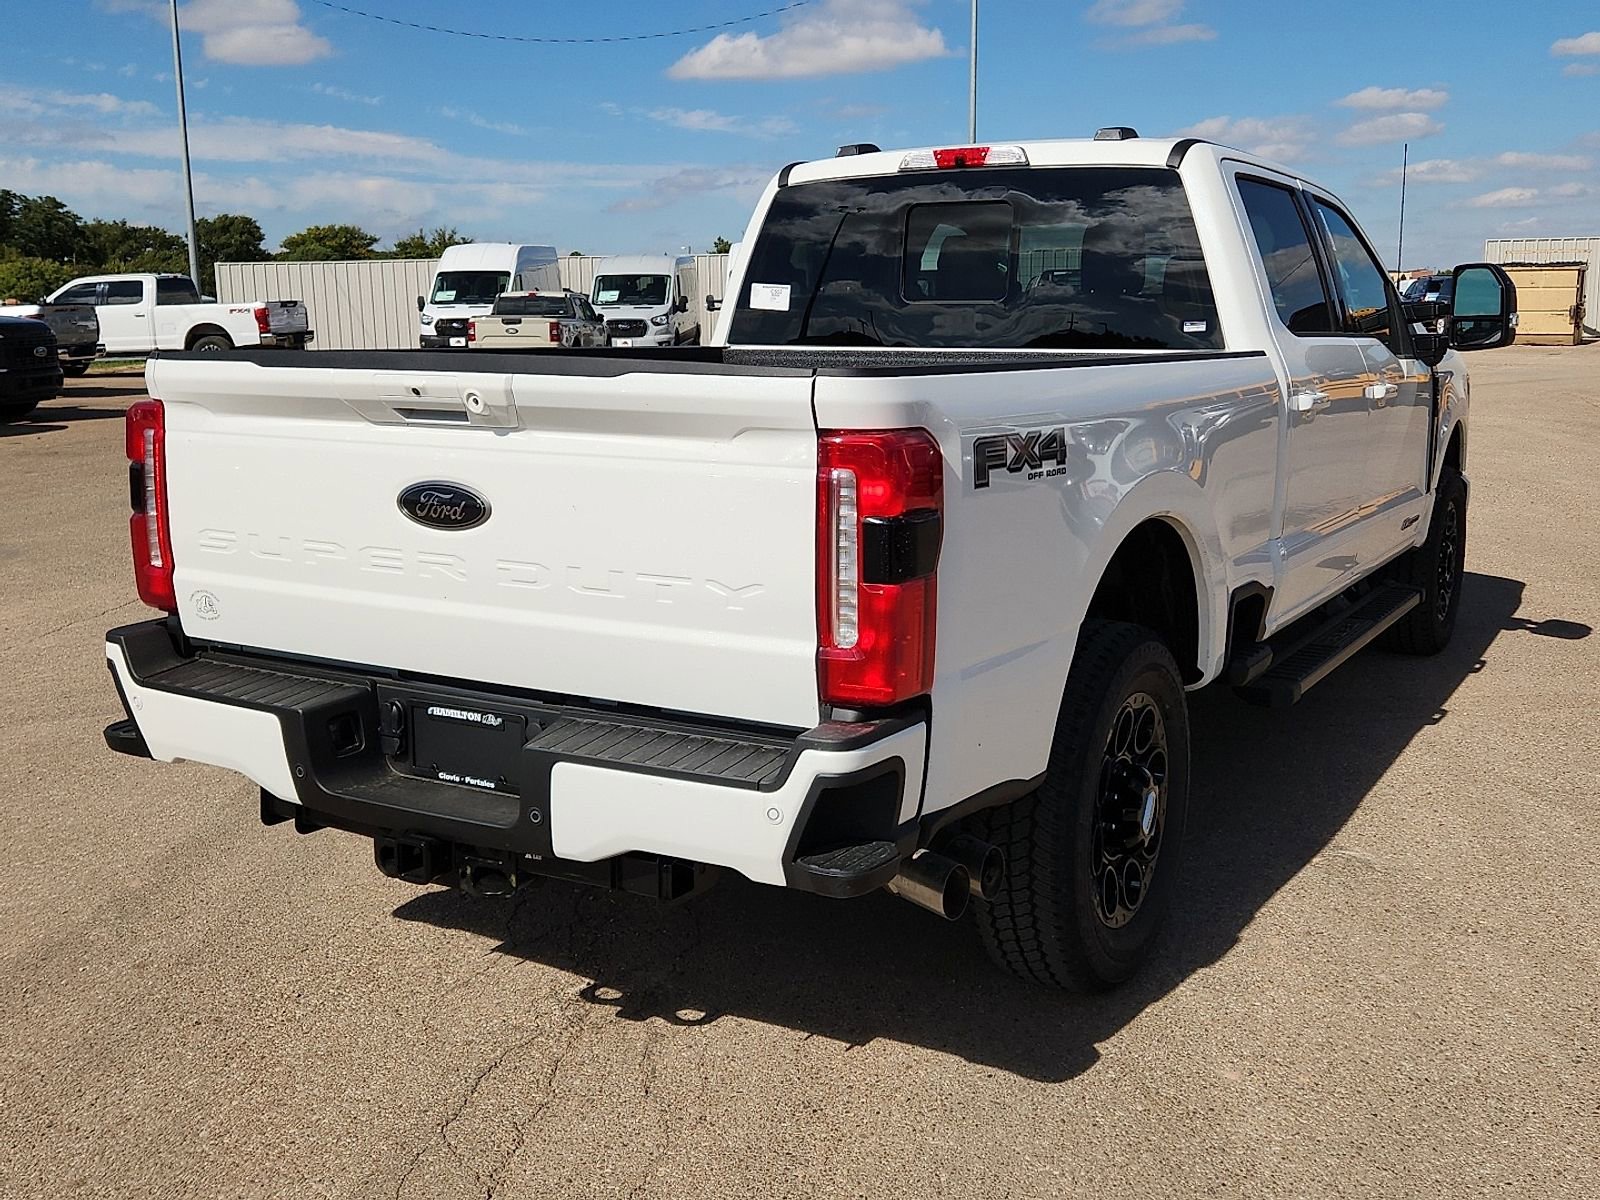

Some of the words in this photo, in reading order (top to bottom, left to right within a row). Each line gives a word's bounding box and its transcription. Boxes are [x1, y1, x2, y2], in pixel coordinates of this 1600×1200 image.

[973, 427, 1067, 489] FX4
[1028, 471, 1043, 480] OFF
[1046, 467, 1066, 477] ROAD
[415, 490, 466, 520] Ford
[198, 528, 467, 581] SUPER
[496, 559, 765, 610] DUTY
[427, 706, 481, 722] HAMILTON
[438, 772, 460, 782] Clovis
[465, 776, 495, 788] Portales
